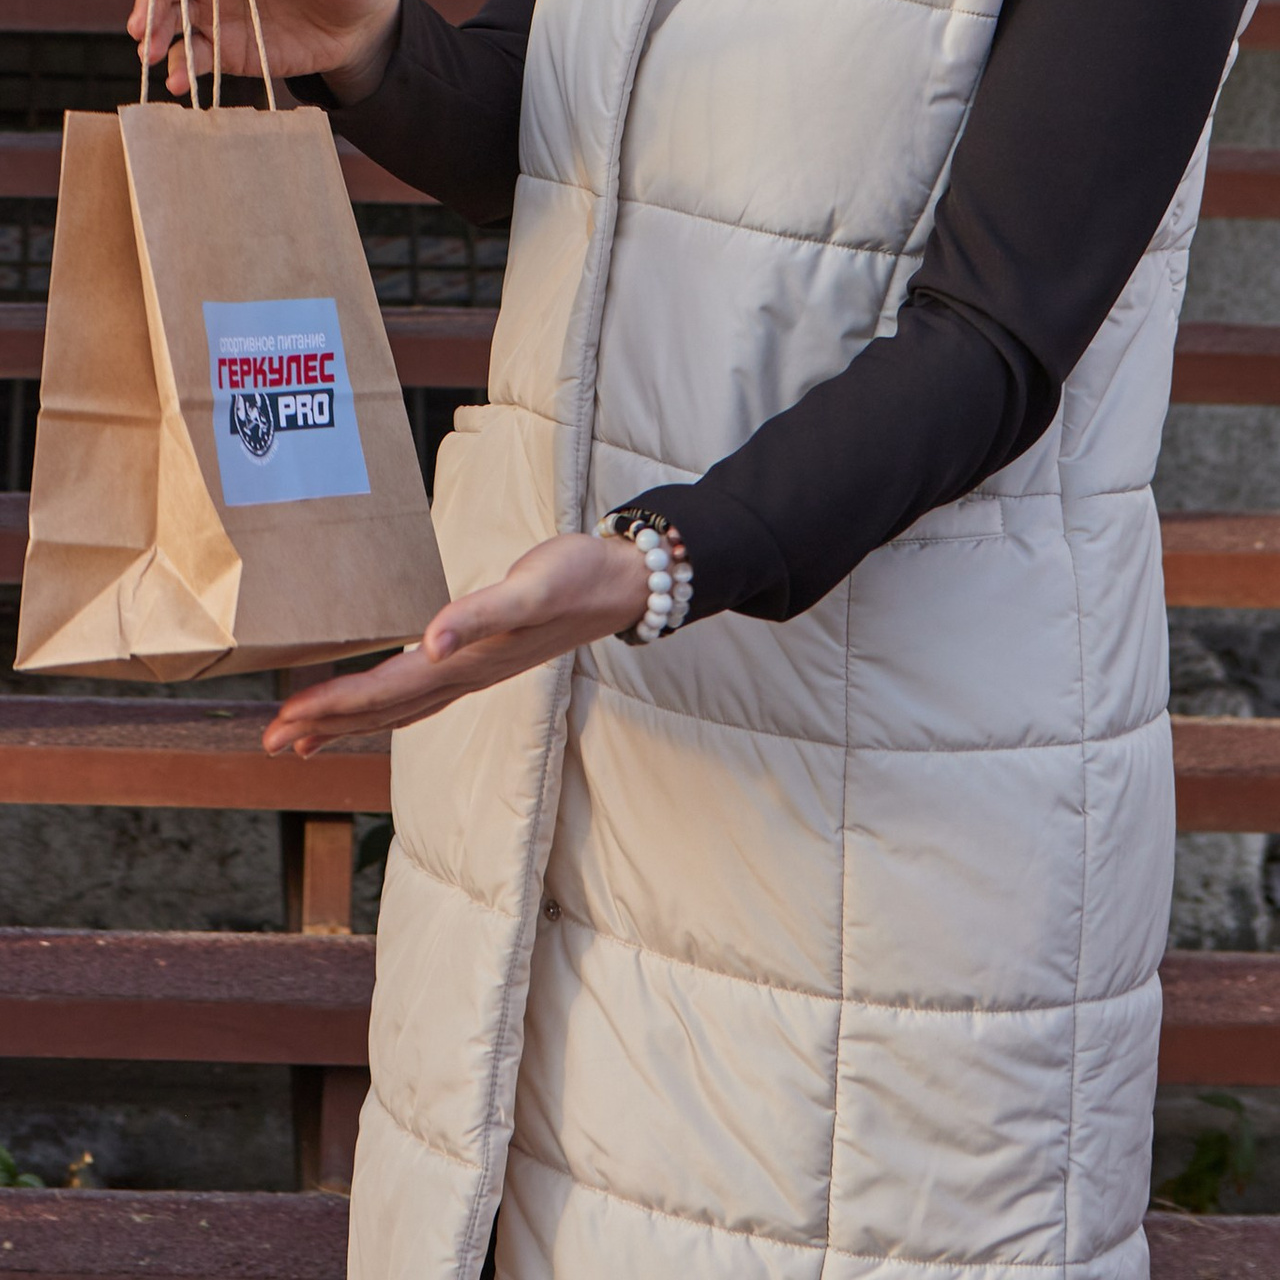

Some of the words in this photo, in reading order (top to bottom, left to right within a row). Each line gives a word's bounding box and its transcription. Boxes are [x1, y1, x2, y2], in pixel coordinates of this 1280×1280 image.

[277, 332, 326, 351] питание
[218, 352, 335, 389] ГЕРКУЛЕС
[277, 393, 330, 428] PRO
